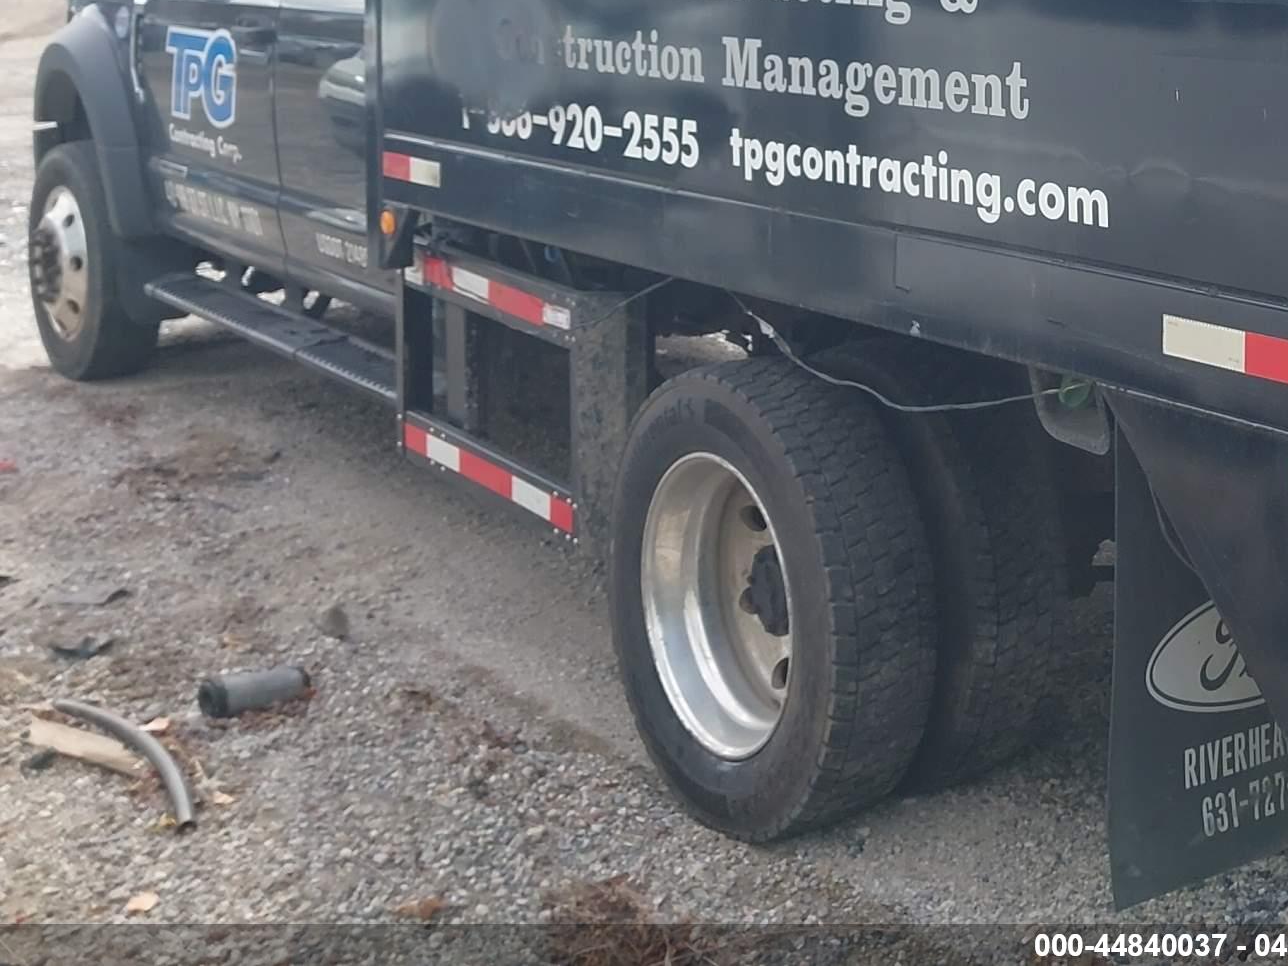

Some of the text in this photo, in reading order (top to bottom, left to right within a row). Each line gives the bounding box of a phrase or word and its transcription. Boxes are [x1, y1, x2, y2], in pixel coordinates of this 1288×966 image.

[165, 25, 237, 129] TPG
[722, 36, 1030, 120] Management
[729, 128, 1110, 229] tpgcontracting.com
